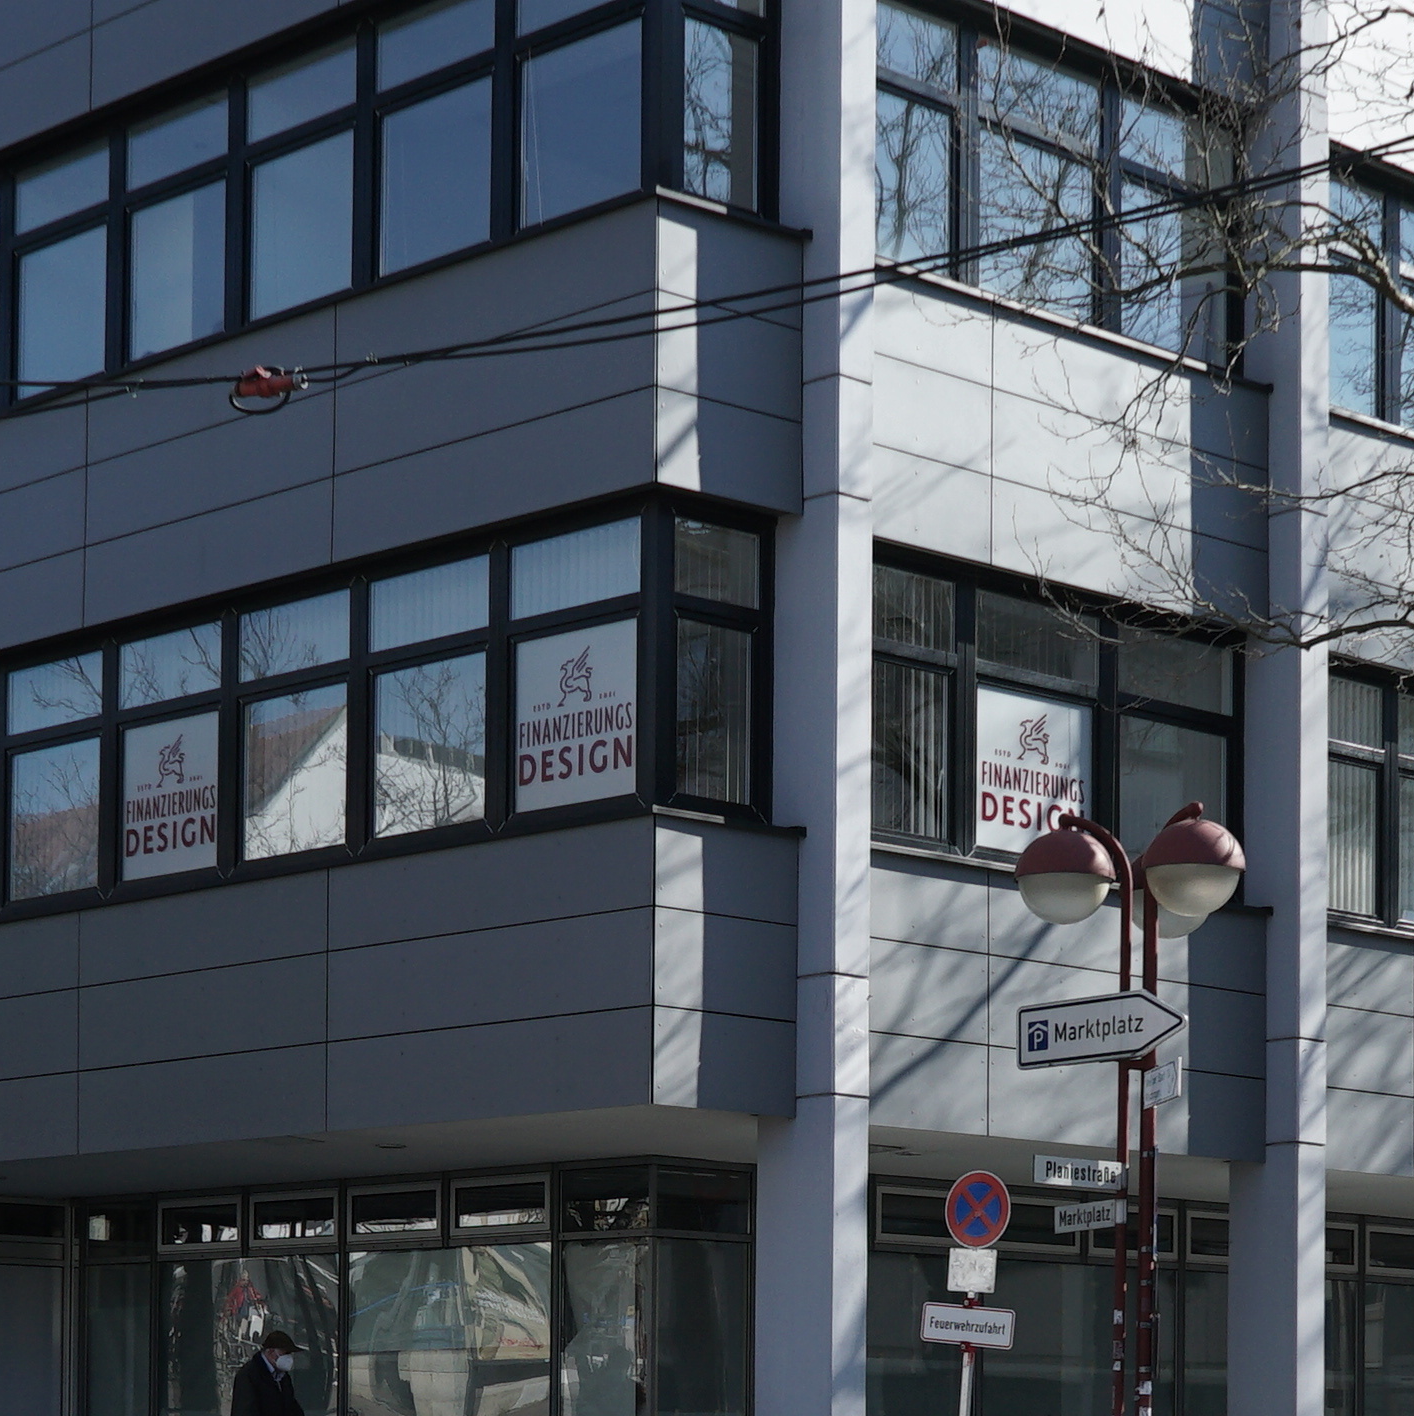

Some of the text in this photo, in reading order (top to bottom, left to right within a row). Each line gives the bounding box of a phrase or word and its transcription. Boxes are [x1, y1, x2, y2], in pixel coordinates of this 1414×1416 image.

[520, 702, 632, 749] FINANZIERUNGS
[519, 734, 632, 786] DESIGN
[982, 761, 1085, 805] FINANZIERUNGS
[127, 784, 216, 824] FINANZIERUNGS
[981, 791, 1085, 832] DESIG
[126, 814, 215, 857] DESIGN
[1054, 1014, 1144, 1044] Marktplatz
[1045, 1160, 1117, 1184] Planiestraße
[1059, 1206, 1111, 1228] Marktplatz
[929, 1316, 1006, 1336] Feuerwehrzufahrt
